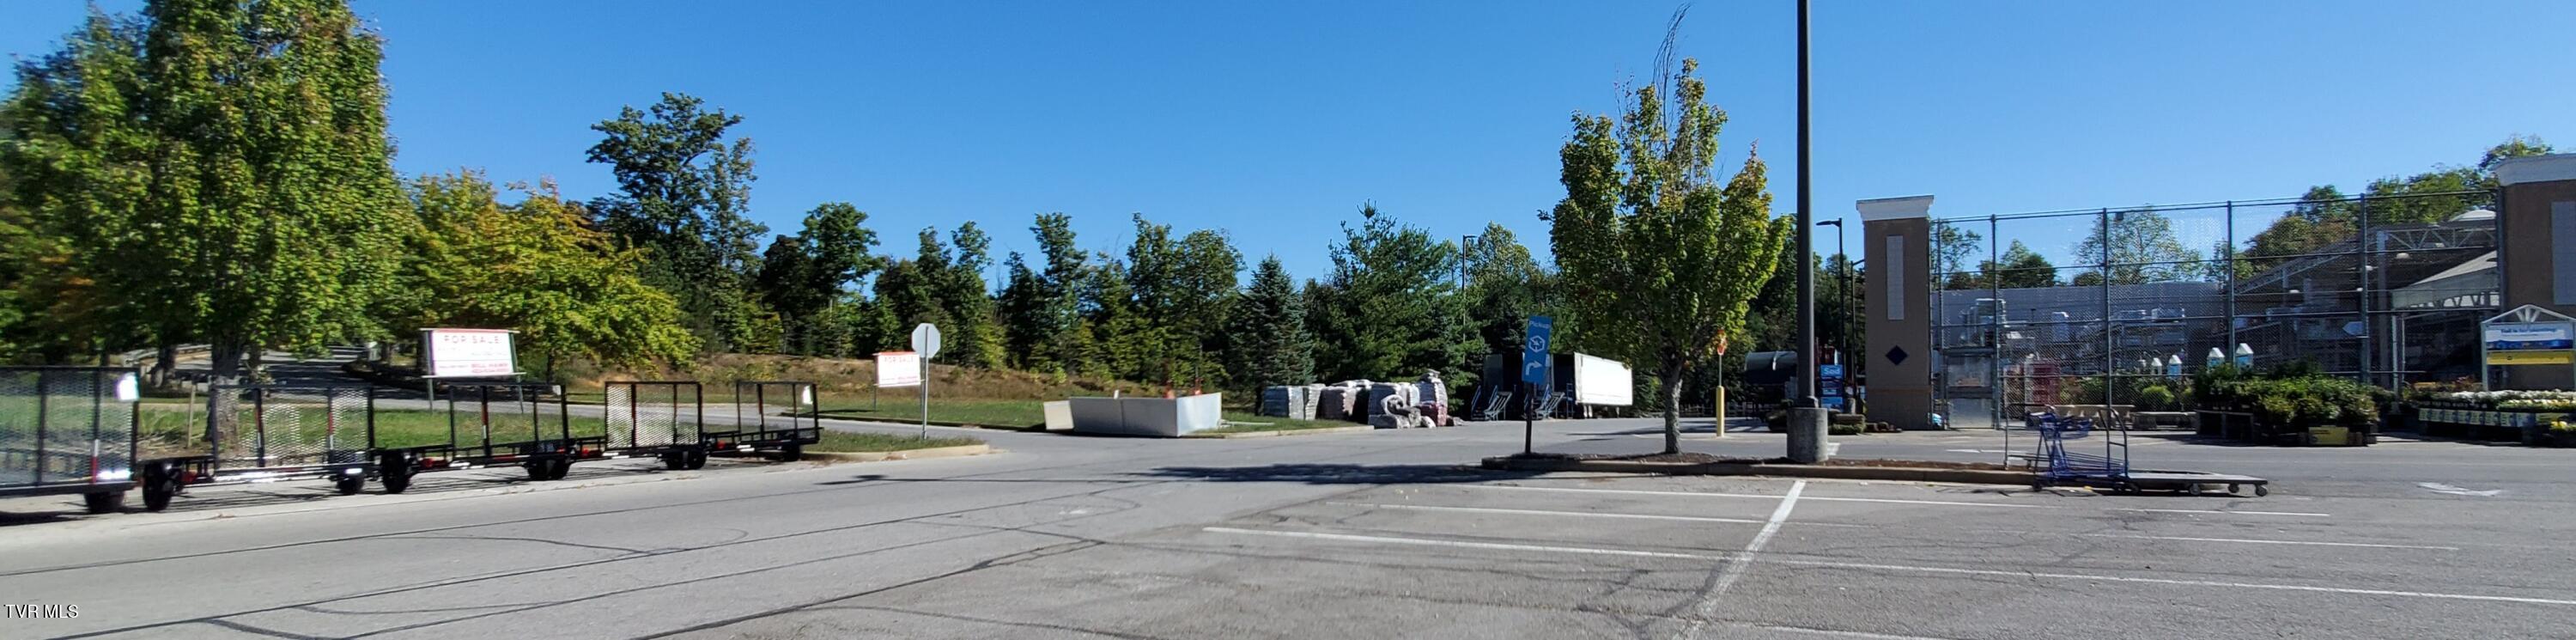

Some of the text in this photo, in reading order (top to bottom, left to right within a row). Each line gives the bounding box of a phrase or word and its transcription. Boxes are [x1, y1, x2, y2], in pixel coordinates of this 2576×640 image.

[1528, 320, 1551, 330] Pickup
[444, 334, 502, 344] FOR SALE
